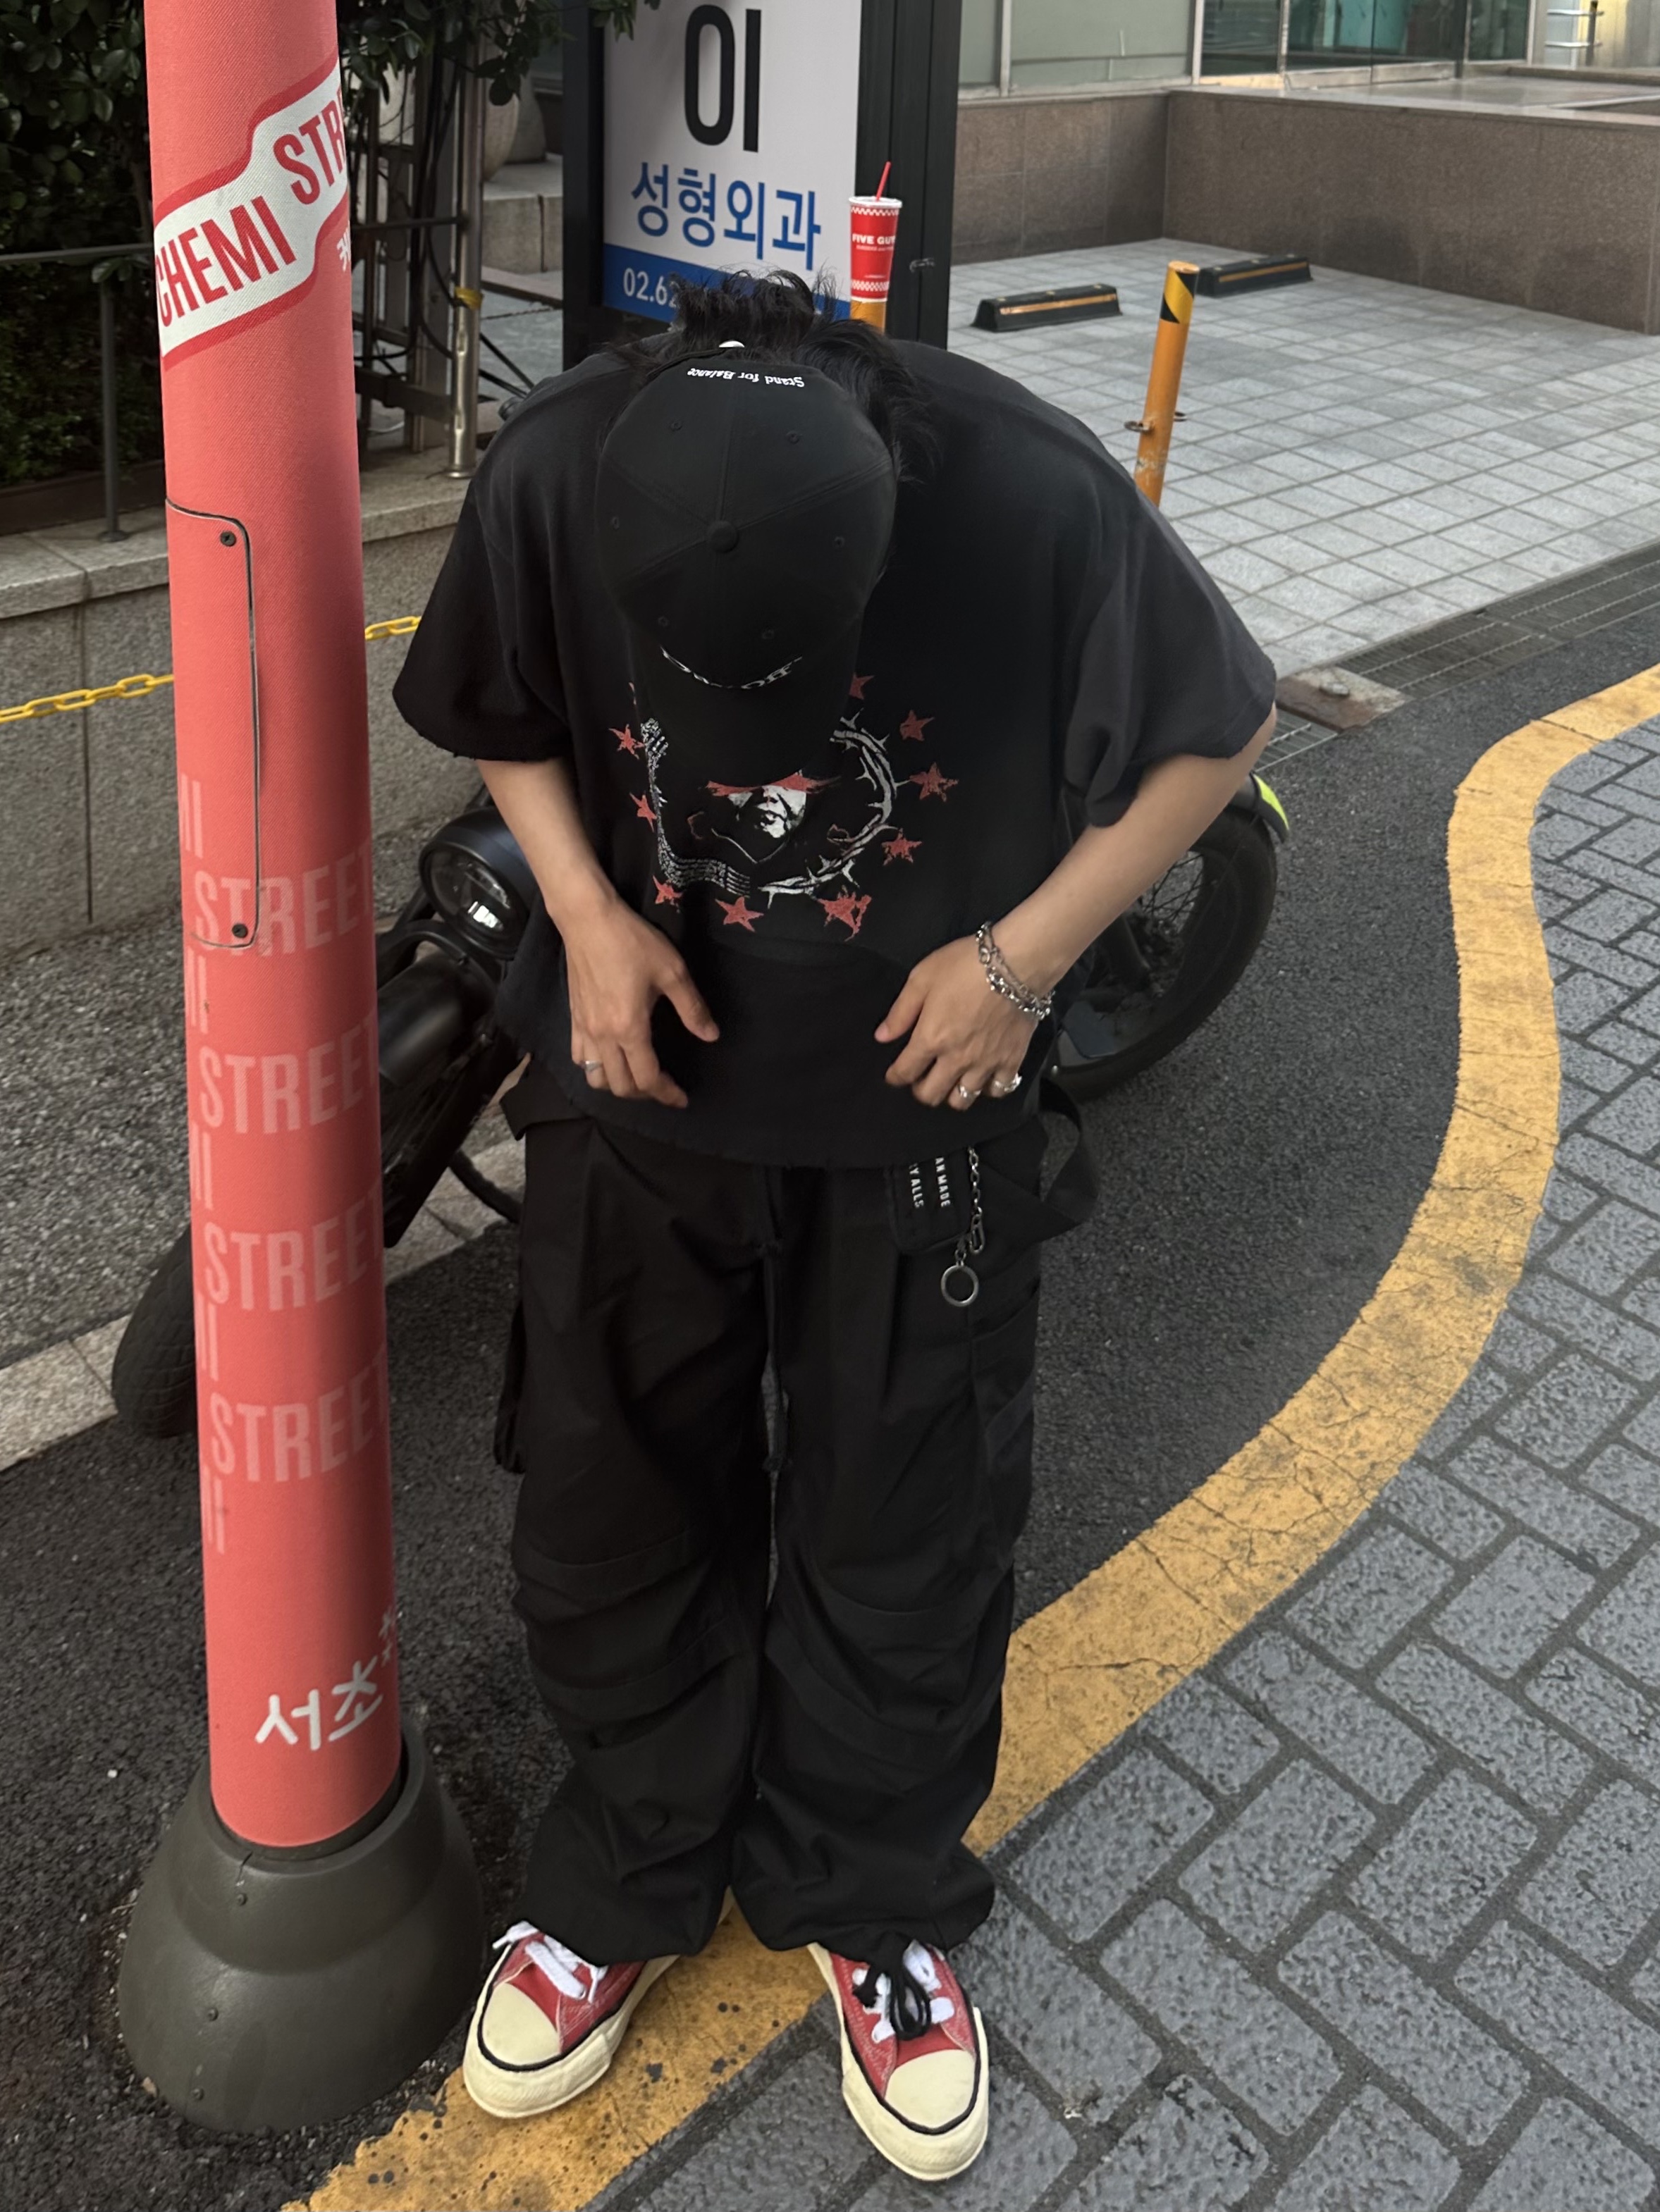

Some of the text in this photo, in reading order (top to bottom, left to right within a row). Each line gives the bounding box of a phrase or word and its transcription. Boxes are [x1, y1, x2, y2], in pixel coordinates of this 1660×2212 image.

[273, 85, 345, 205] STR
[632, 161, 821, 271] 성형외과
[851, 233, 875, 245] FIVE
[687, 368, 805, 388] Stand for Balance
[254, 1655, 384, 1751] 서초
